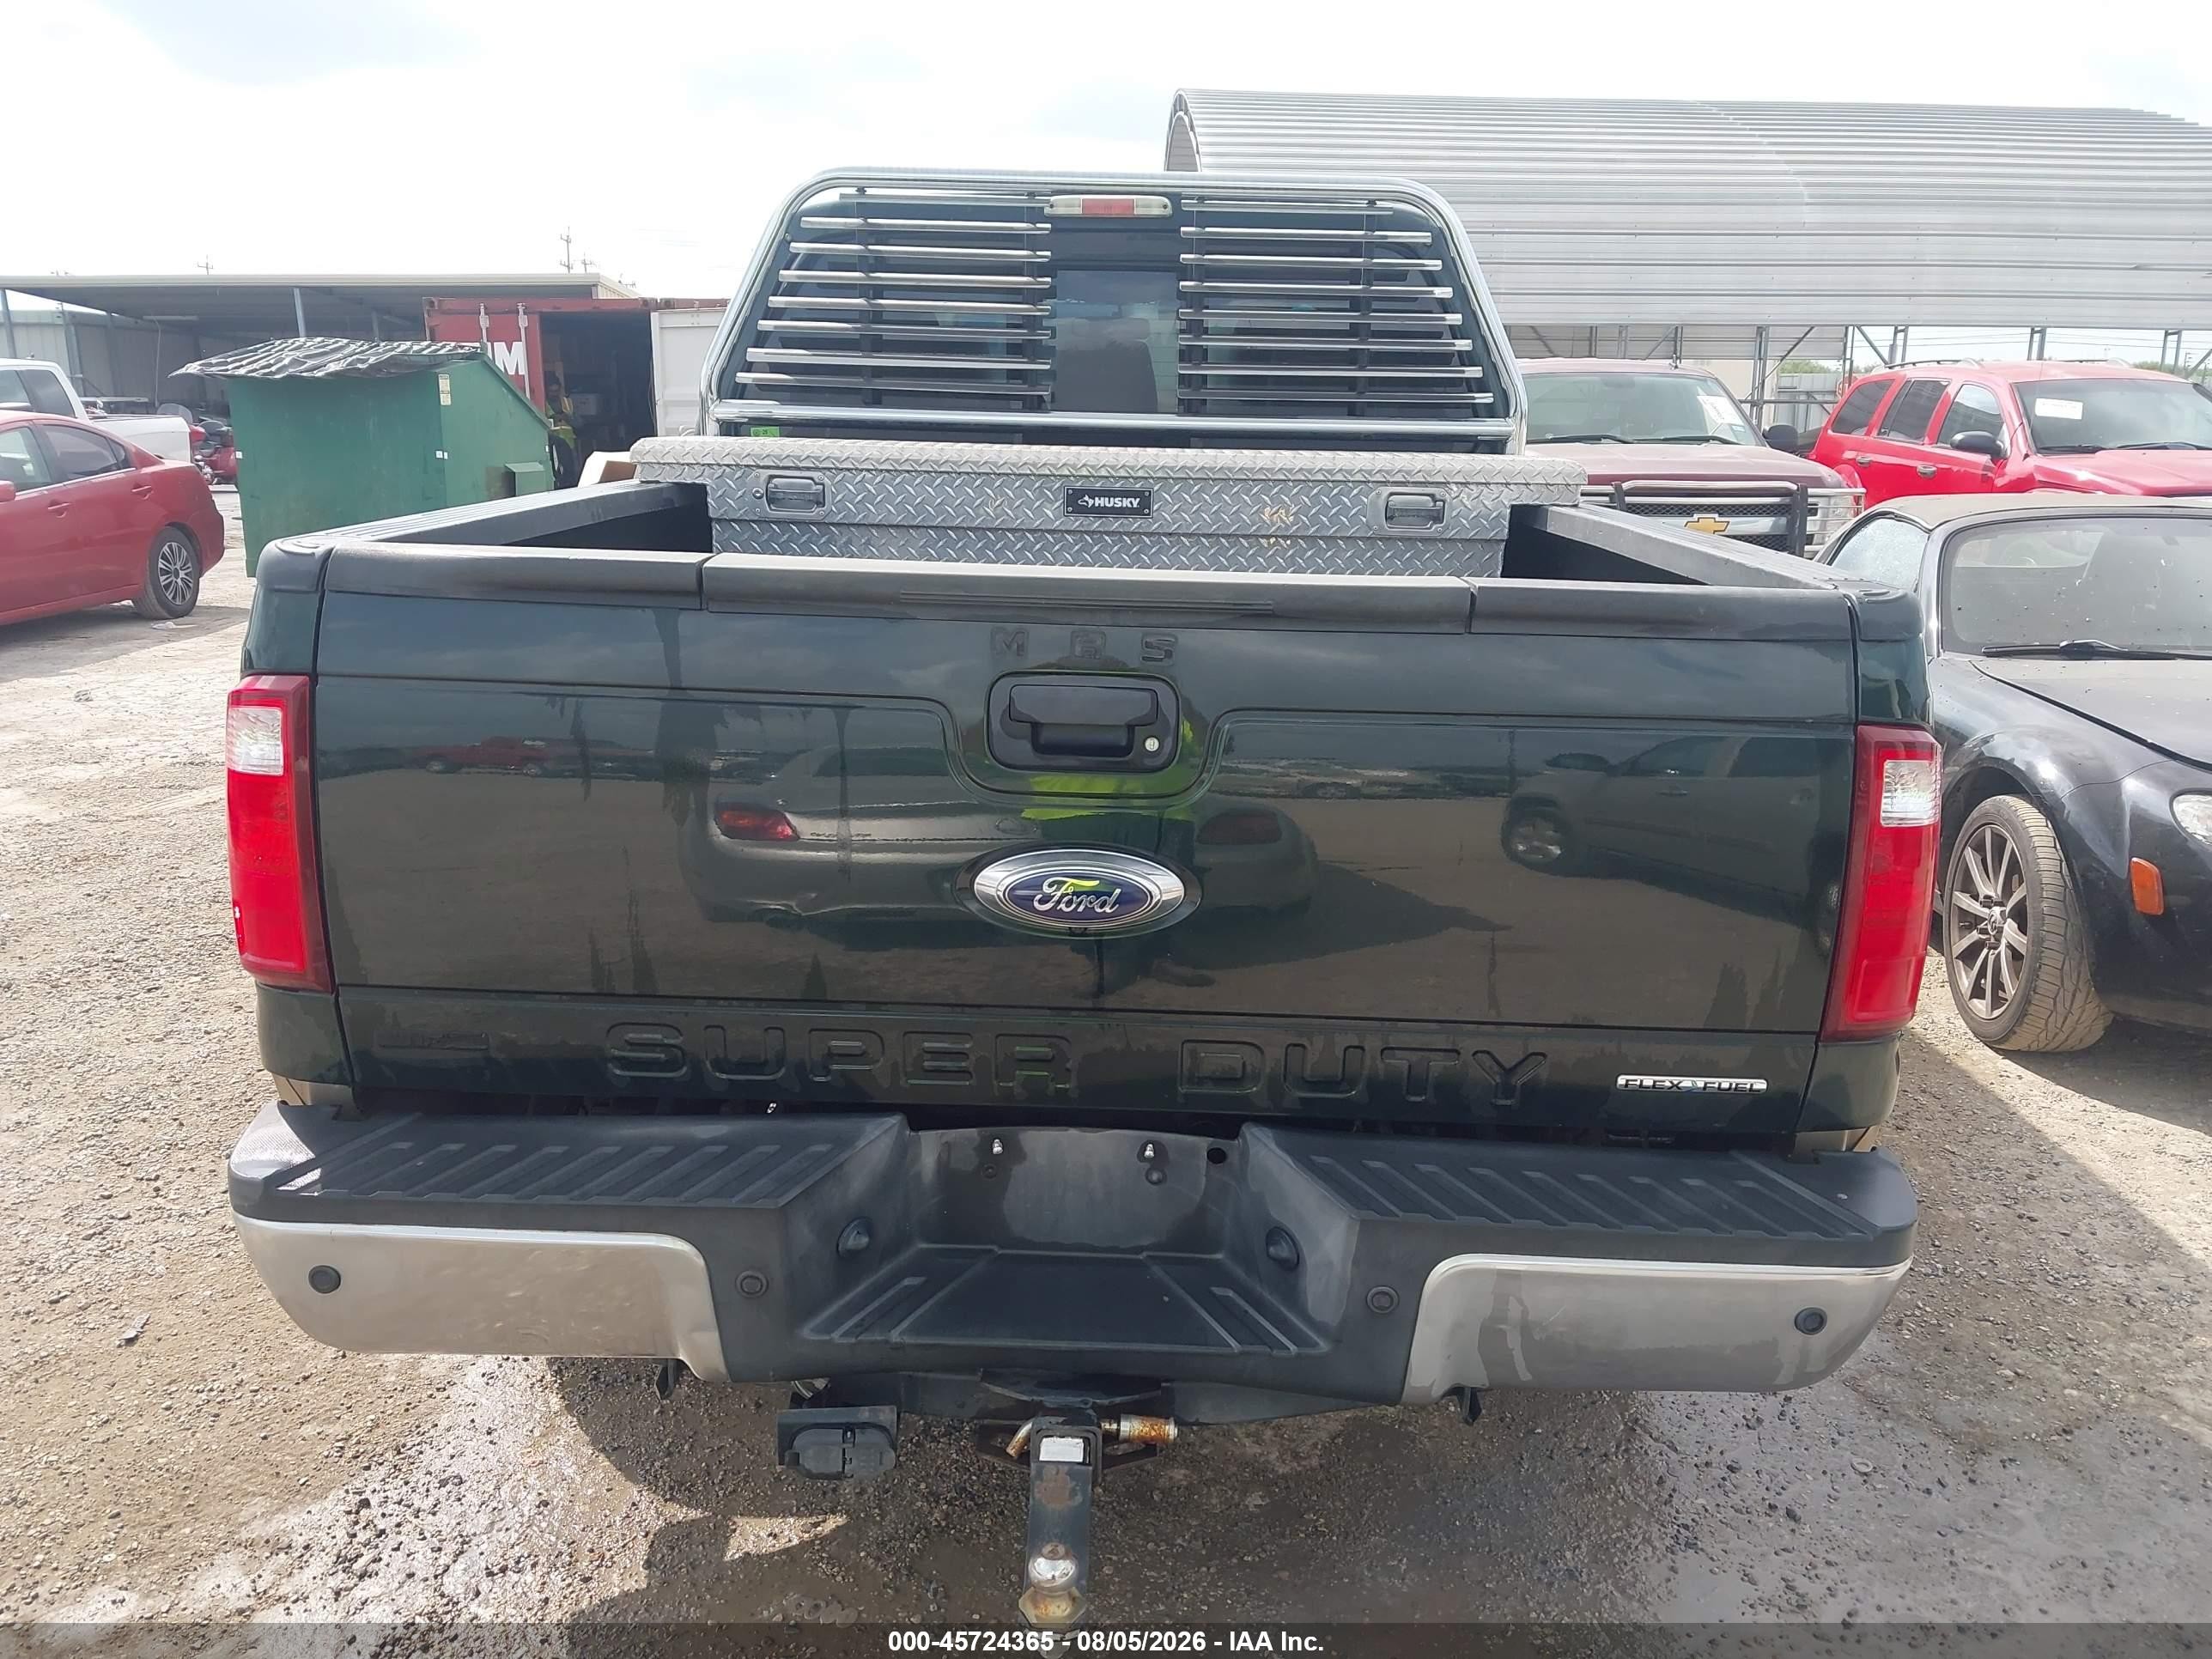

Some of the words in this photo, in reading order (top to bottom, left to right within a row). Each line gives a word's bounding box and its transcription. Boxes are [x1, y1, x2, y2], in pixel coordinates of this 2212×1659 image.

[1094, 496, 1140, 508] HUSKY
[1033, 876, 1121, 914] Ford
[605, 1021, 1073, 1091] SUPER
[1177, 1038, 1548, 1106] DUTY
[1624, 1079, 1684, 1091] FLEX
[1702, 1080, 1763, 1093] FUEL
